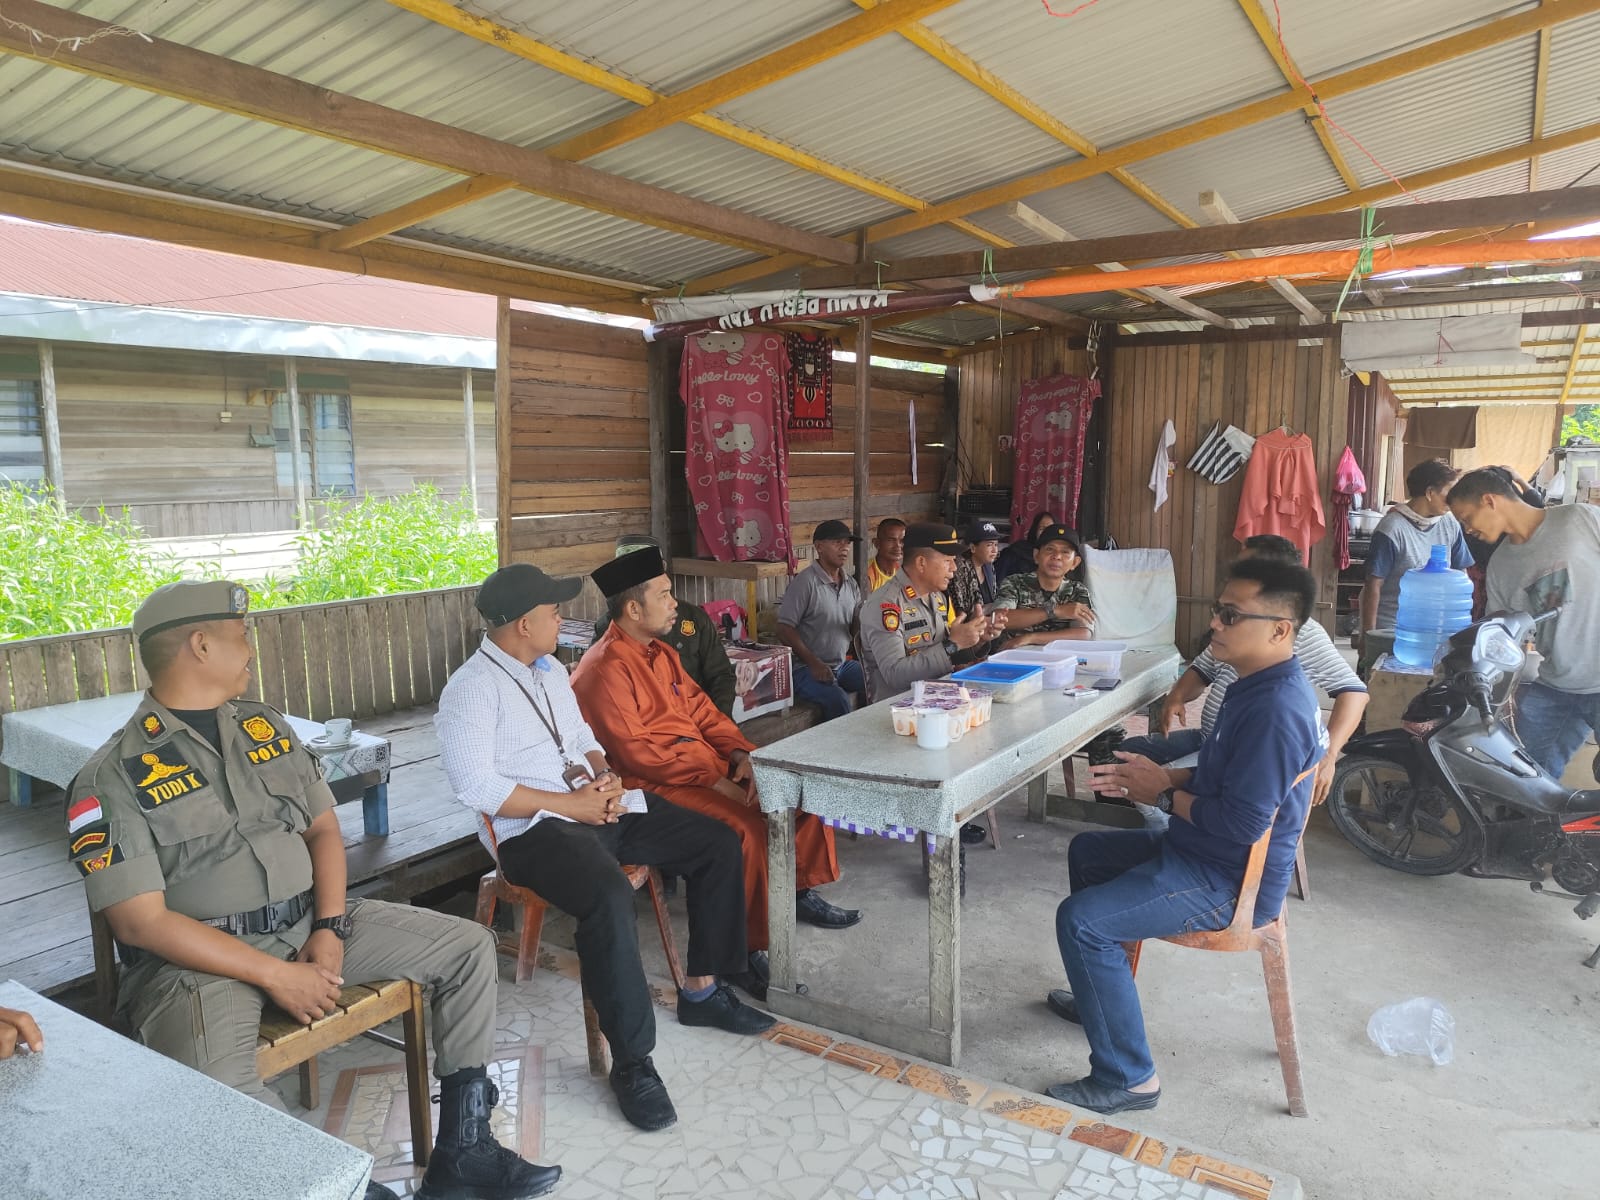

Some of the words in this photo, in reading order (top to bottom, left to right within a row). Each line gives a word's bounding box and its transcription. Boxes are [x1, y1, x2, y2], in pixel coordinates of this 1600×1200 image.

[760, 297, 820, 322] PERLU
[827, 294, 888, 314] KAMU
[718, 310, 753, 330] TAU
[247, 743, 280, 764] POL
[146, 777, 190, 805] YUDI
[184, 772, 203, 789] K
